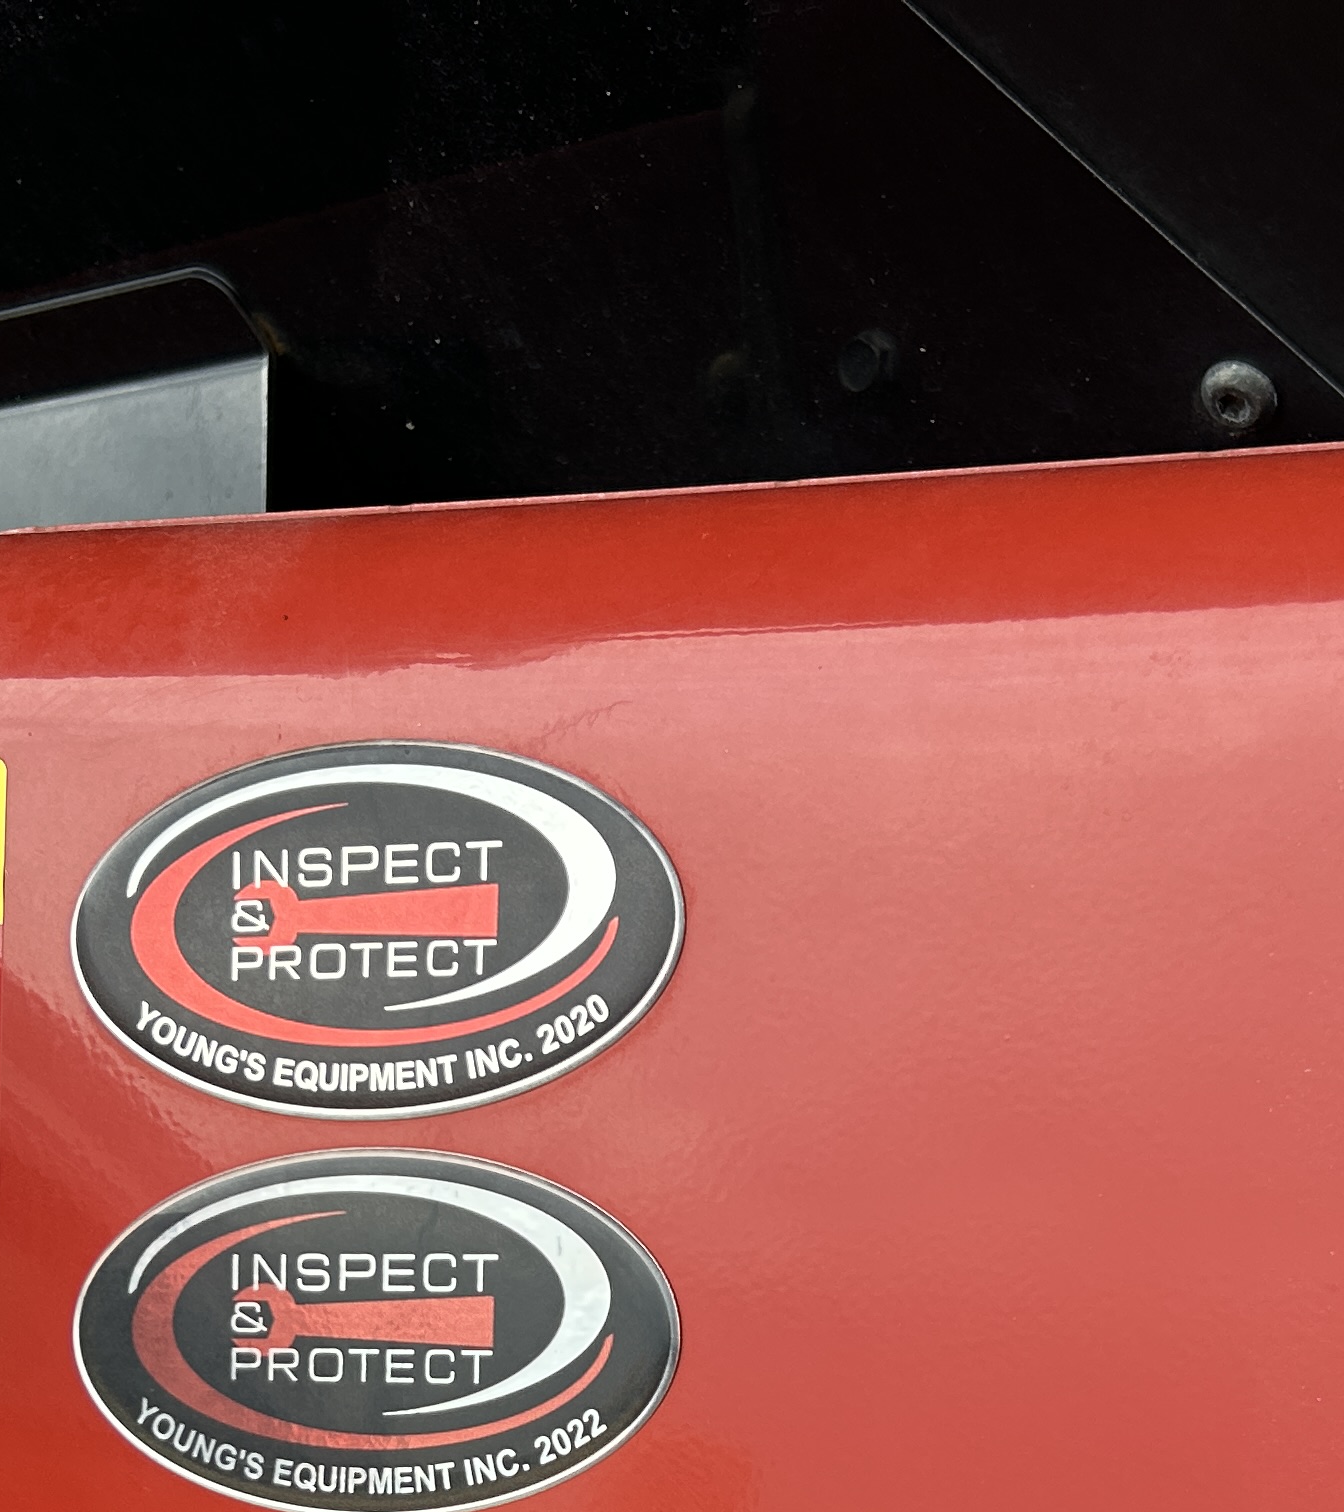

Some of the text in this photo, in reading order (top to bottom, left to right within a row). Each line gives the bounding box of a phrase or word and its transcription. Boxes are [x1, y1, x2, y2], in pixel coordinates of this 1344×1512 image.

[232, 840, 504, 890] INSPECT
[231, 898, 270, 933] &
[231, 938, 499, 983] PROTECT
[134, 994, 612, 1093] YOUNG'S EQUIPMENT INC. 2020
[231, 1252, 500, 1294] INSPECT
[230, 1301, 268, 1335] &
[230, 1346, 495, 1386] PROTECT
[134, 1397, 610, 1496] YOUNG'S EQUIPMENT INC. 2022
